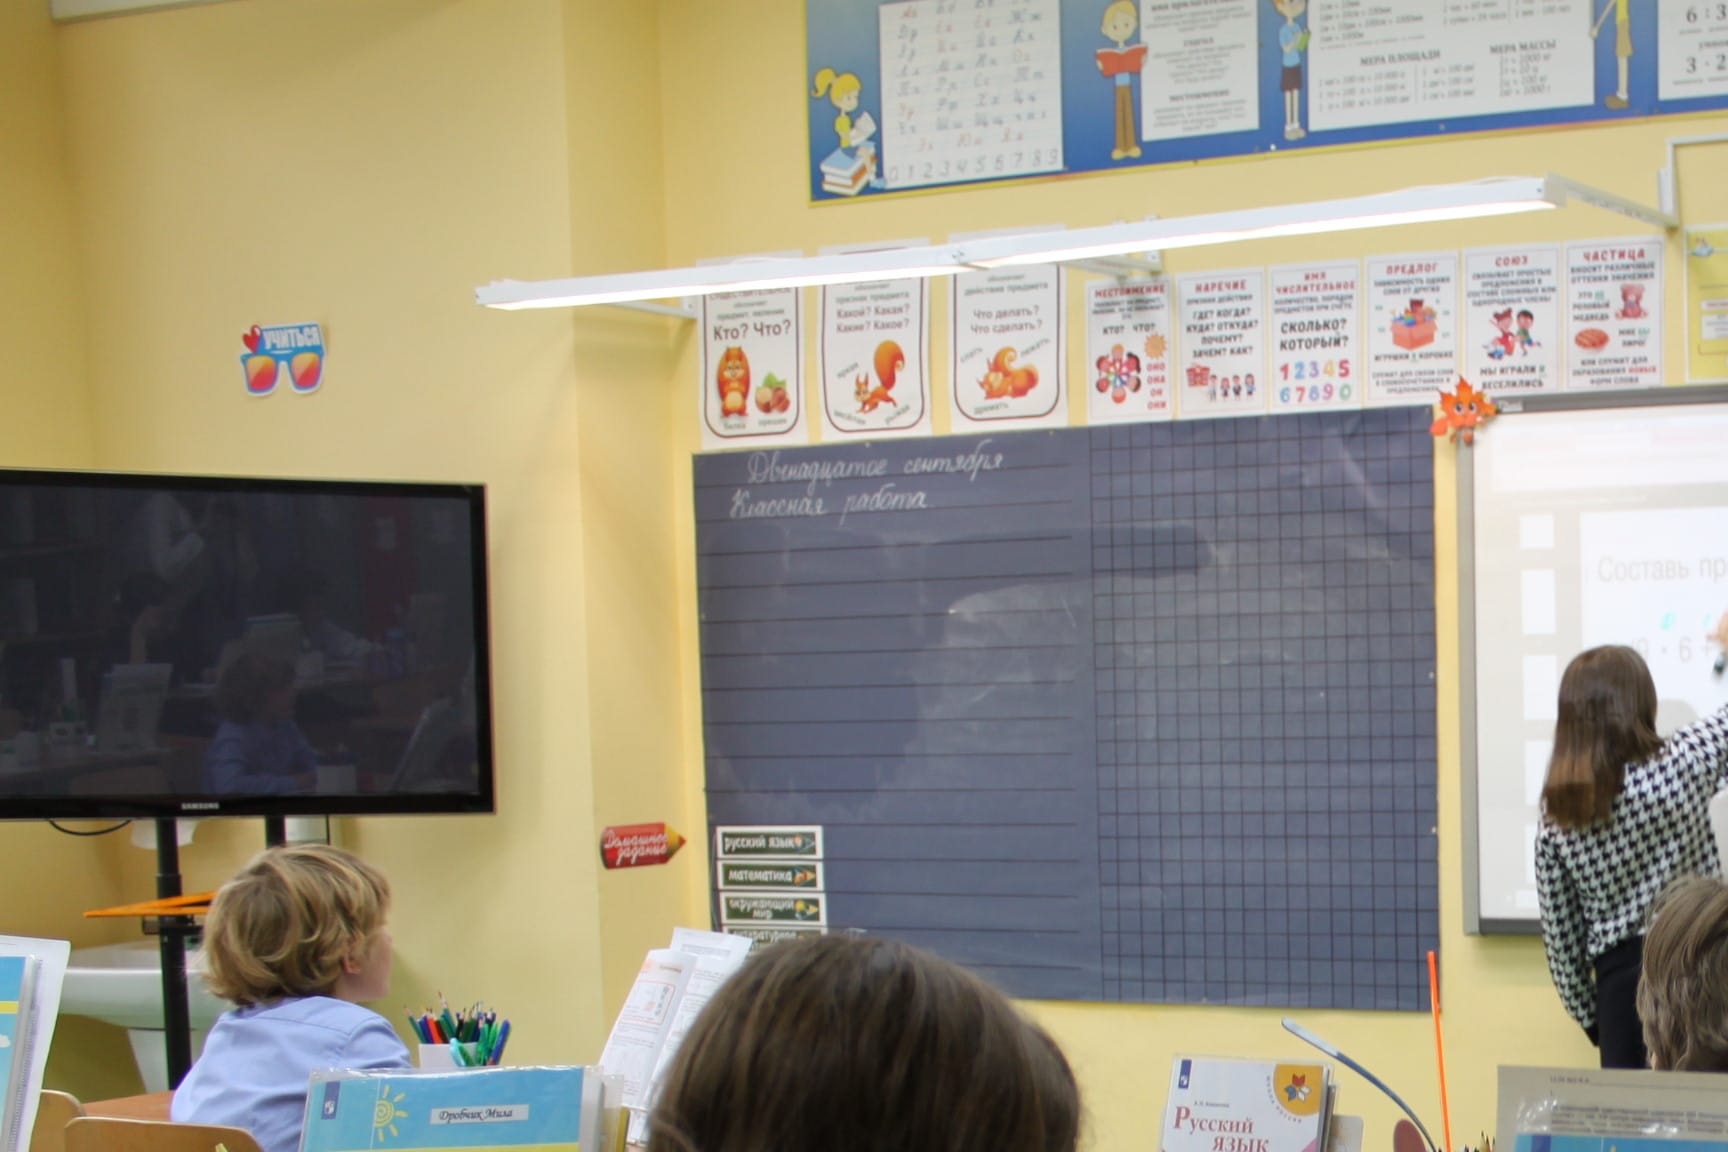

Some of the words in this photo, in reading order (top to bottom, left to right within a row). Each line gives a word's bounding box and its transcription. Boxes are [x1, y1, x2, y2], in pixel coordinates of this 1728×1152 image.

[1686, 6, 1698, 23] 6
[1716, 4, 1727, 21] 3
[1686, 57, 1697, 73] 3
[1716, 53, 1726, 71] 2
[1495, 255, 1528, 267] СОЮЗ
[1583, 248, 1645, 262] ЧАСТИЦА
[1386, 262, 1438, 275] ПРЕДЛОГ
[1304, 271, 1327, 281] ИМЯ
[1195, 280, 1247, 292] НАРЕЧИЕ
[1275, 281, 1355, 295] ЧИСЛИТЕЛЬНОЕ
[836, 306, 872, 319] Какой?
[874, 303, 910, 315] Какая?
[973, 309, 992, 319] Что
[994, 305, 1039, 320] делать?
[1193, 309, 1214, 320] ГДЕ?
[1217, 307, 1252, 318] КОГДА?
[713, 321, 749, 341] Кто?
[752, 319, 791, 337] Что?
[836, 321, 872, 333] Какие?
[873, 318, 910, 331] Какое?
[970, 324, 990, 334] Что
[992, 320, 1043, 334] сделать?
[1102, 324, 1125, 335] КТО?
[1132, 322, 1156, 333] ЧТО?
[1186, 323, 1216, 334] КУДА?
[1217, 320, 1259, 332] ОТКУДА?
[1280, 318, 1348, 334] СКОЛЬКО?
[1201, 334, 1243, 345] ПОЧЕМУ?
[1279, 334, 1349, 351] КОТОРЫЙ?
[1193, 348, 1227, 358] ЗАЧЕМ?
[1229, 346, 1253, 356] КАК?
[1146, 362, 1165, 372] ОНО
[1280, 363, 1289, 381] 1
[1294, 360, 1305, 380] 2
[1308, 360, 1319, 378] 3
[1323, 359, 1334, 377] 4
[1338, 358, 1350, 378] 5
[1480, 367, 1496, 376] МЫ
[1499, 365, 1535, 375] ИГРАЛИ
[1147, 375, 1166, 385] ОНА
[1481, 379, 1544, 390] ВЕСЕЛИЛИСЬ
[1150, 388, 1163, 397] ОН
[1279, 386, 1291, 403] 6
[1295, 386, 1305, 403] 7
[1308, 385, 1320, 401] 8
[1322, 383, 1333, 400] 9
[1339, 383, 1352, 400] 0
[1147, 401, 1167, 410] ОНИ
[747, 450, 888, 496] Двенадцатое
[903, 438, 1003, 483] сентября
[729, 487, 824, 518] Классная
[839, 482, 929, 526] работа
[1598, 554, 1690, 584] Составь
[1679, 635, 1693, 662] 6
[604, 828, 668, 849] Домашнее
[724, 835, 766, 851] русский
[768, 835, 795, 848] язык
[616, 842, 667, 866] задание
[728, 868, 793, 882] математика
[752, 909, 772, 920] мир
[485, 1106, 513, 1119] Мила
[1173, 1105, 1255, 1135] Русский
